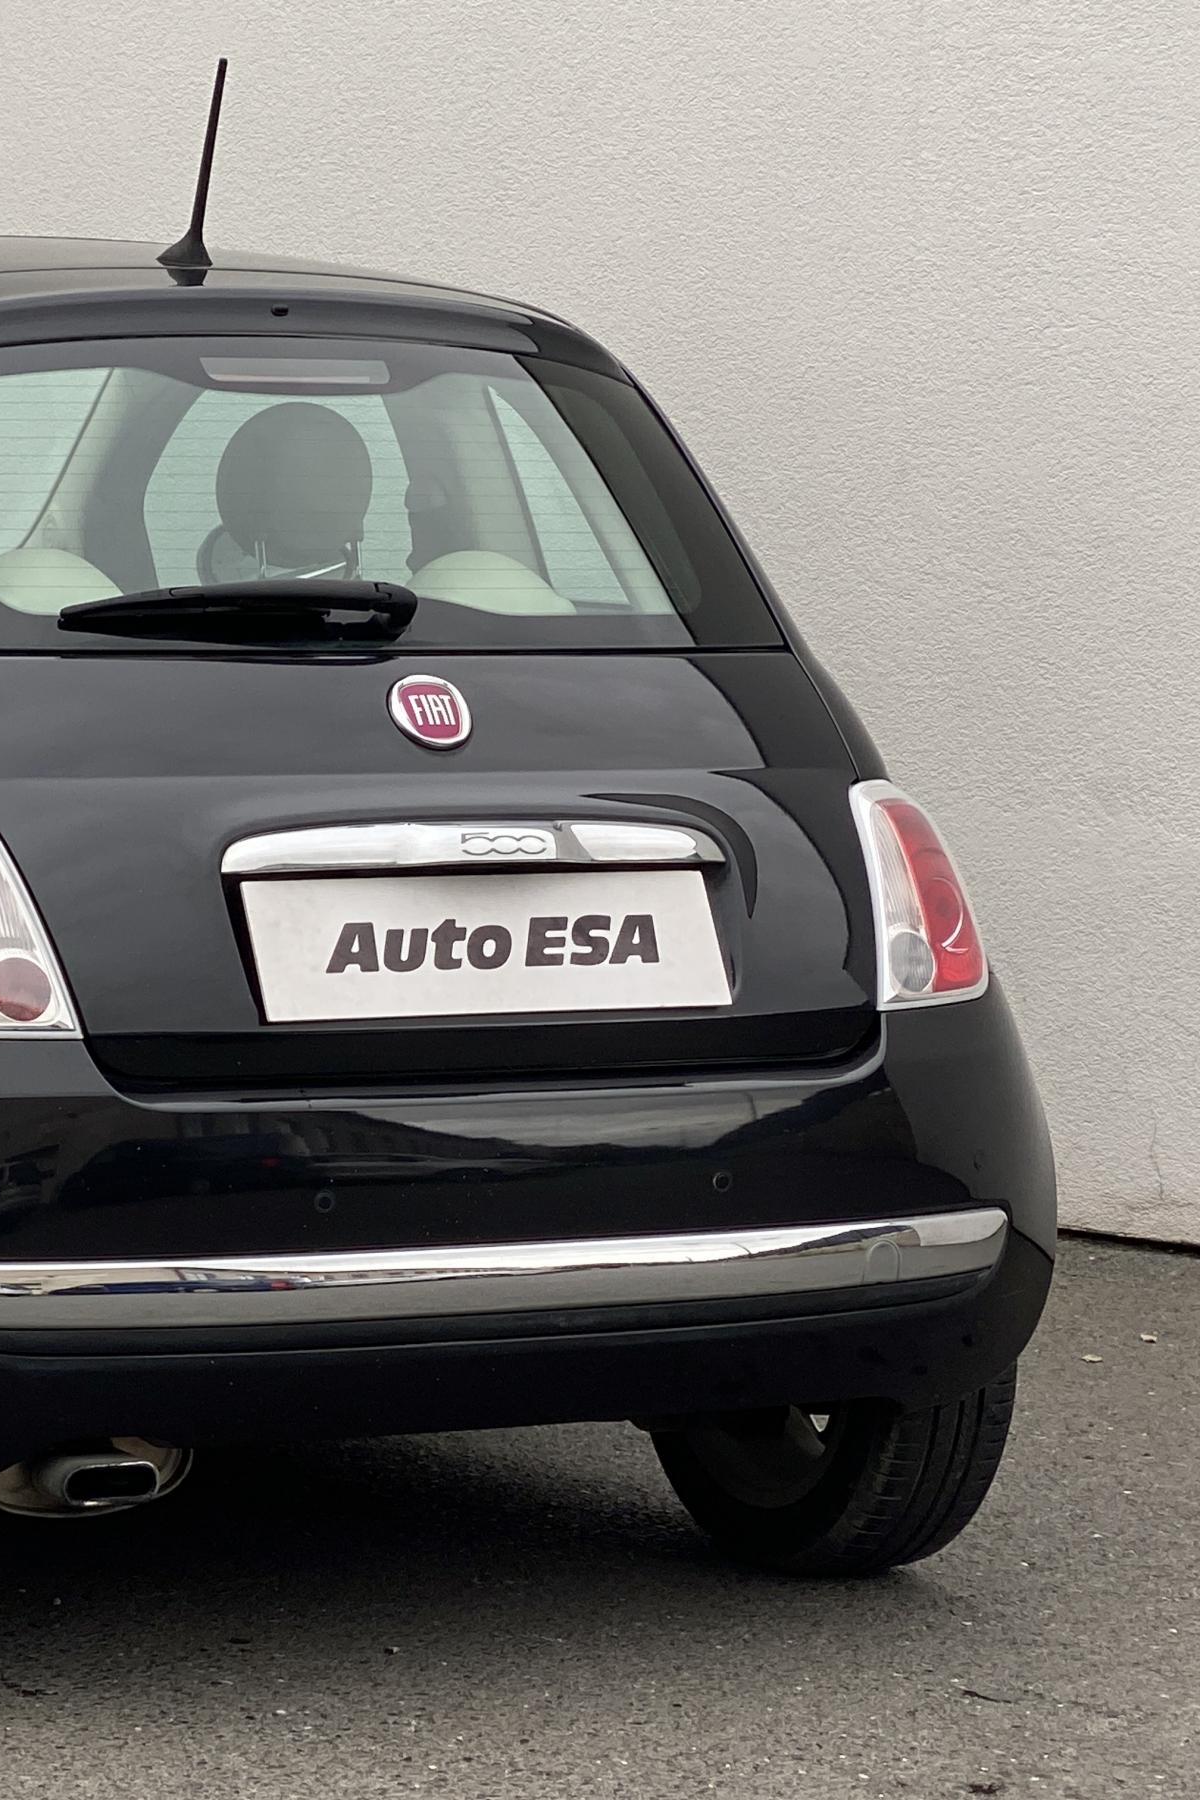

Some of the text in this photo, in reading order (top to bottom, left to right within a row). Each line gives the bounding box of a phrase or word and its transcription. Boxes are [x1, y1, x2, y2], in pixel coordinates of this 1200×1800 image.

[408, 694, 456, 726] FIAT
[461, 832, 547, 856] 500
[325, 914, 660, 974] Auto ESA
